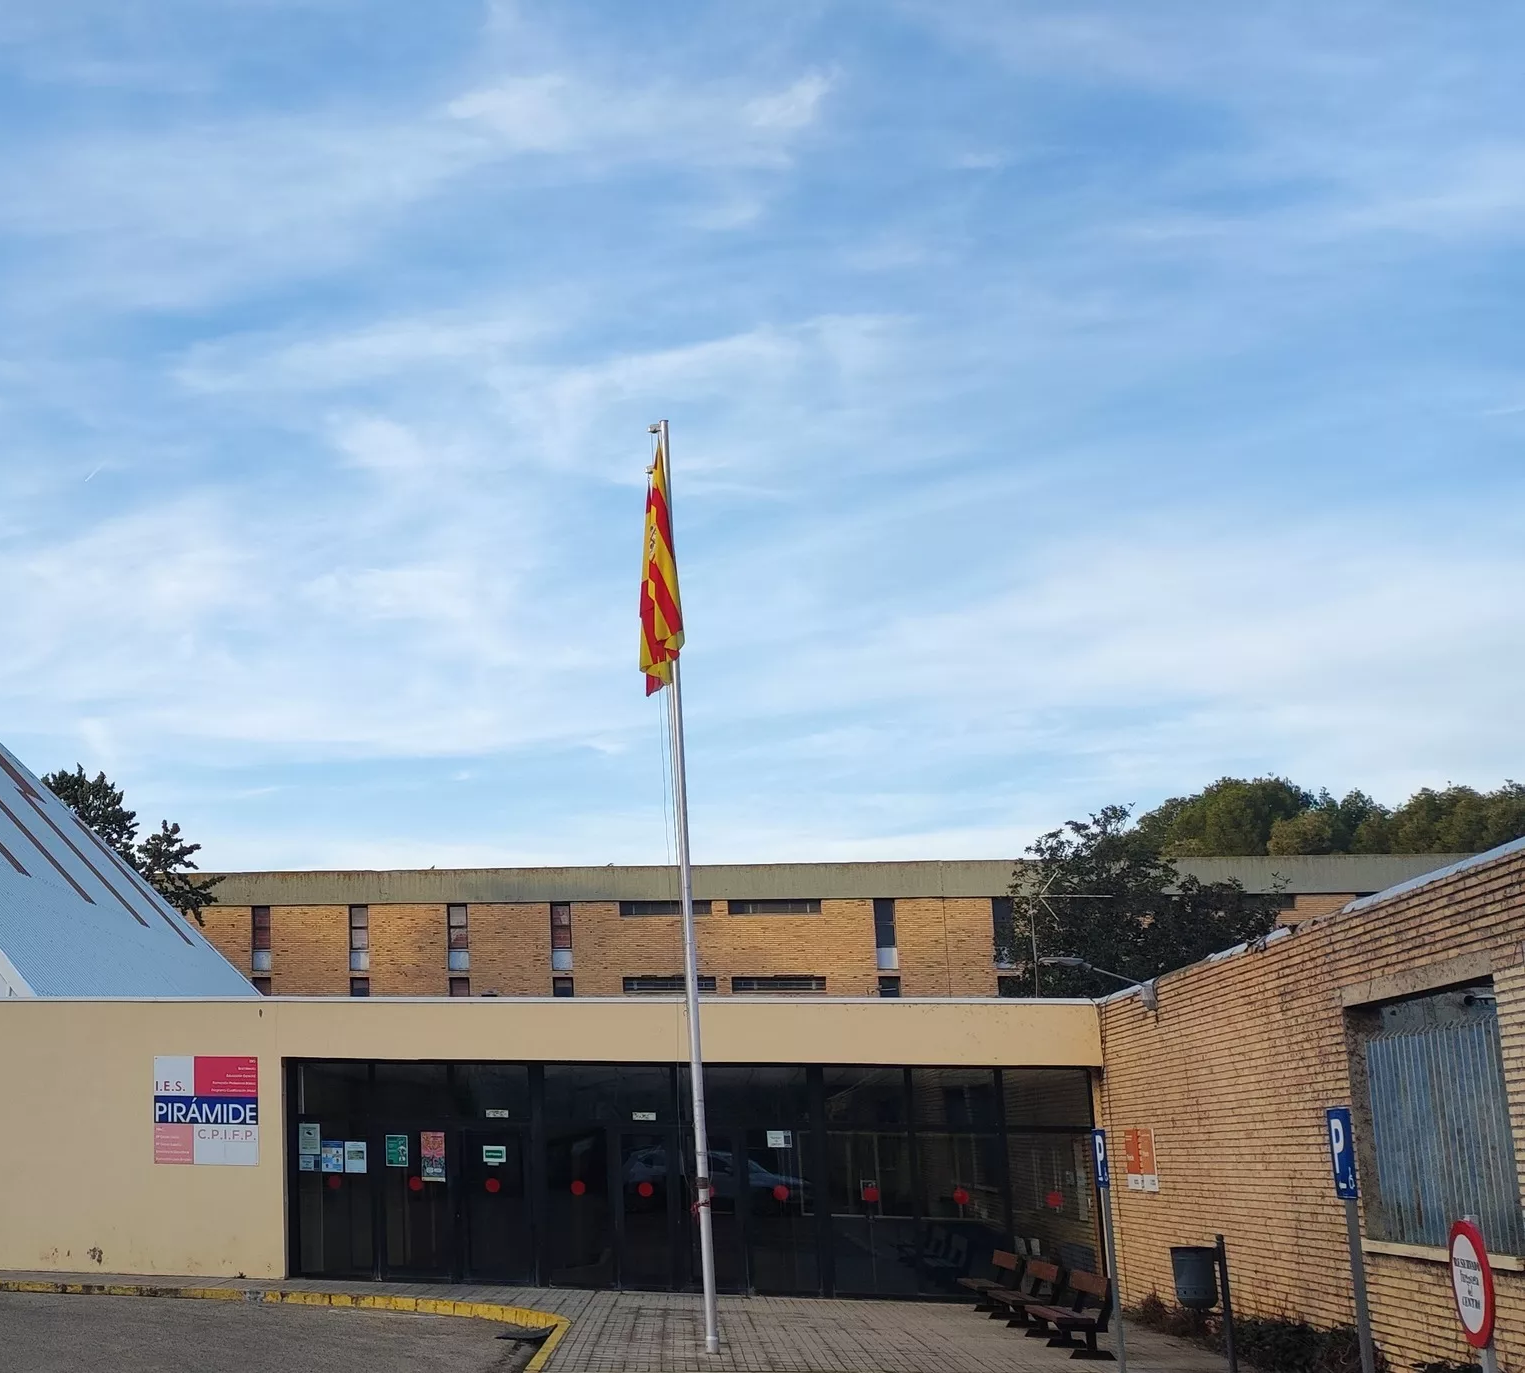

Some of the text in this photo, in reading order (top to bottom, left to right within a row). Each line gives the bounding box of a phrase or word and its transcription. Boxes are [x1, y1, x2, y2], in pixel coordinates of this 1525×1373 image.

[156, 1080, 185, 1092] I.E.S.
[155, 1097, 257, 1124] PIRÁMIDE
[198, 1129, 256, 1140] C.P.I.F.P.
[1330, 1118, 1344, 1174] P
[1095, 1135, 1104, 1176] P
